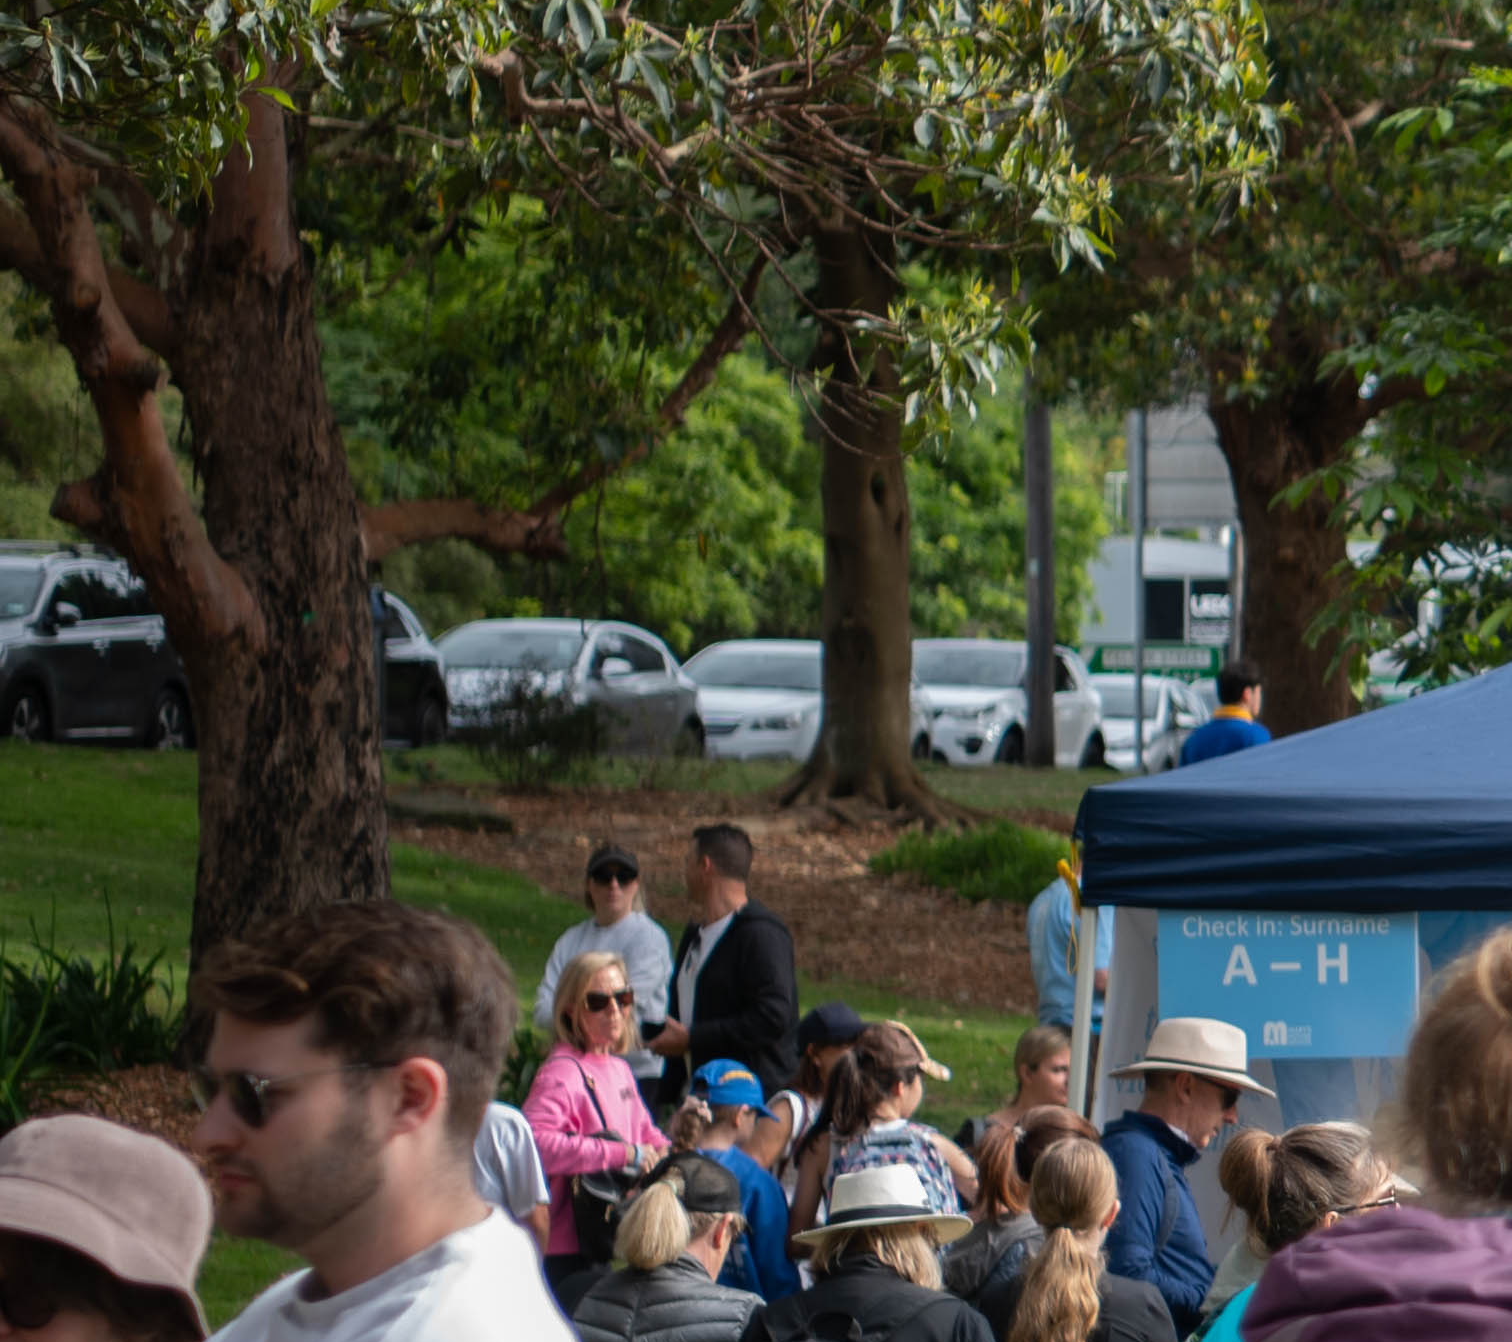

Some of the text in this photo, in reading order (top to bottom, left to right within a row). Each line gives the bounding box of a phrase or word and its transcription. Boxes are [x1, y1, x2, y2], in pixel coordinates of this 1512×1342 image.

[1182, 914, 1391, 938] Check in: Surname
[1222, 944, 1258, 986] A
[1317, 943, 1349, 984] H
